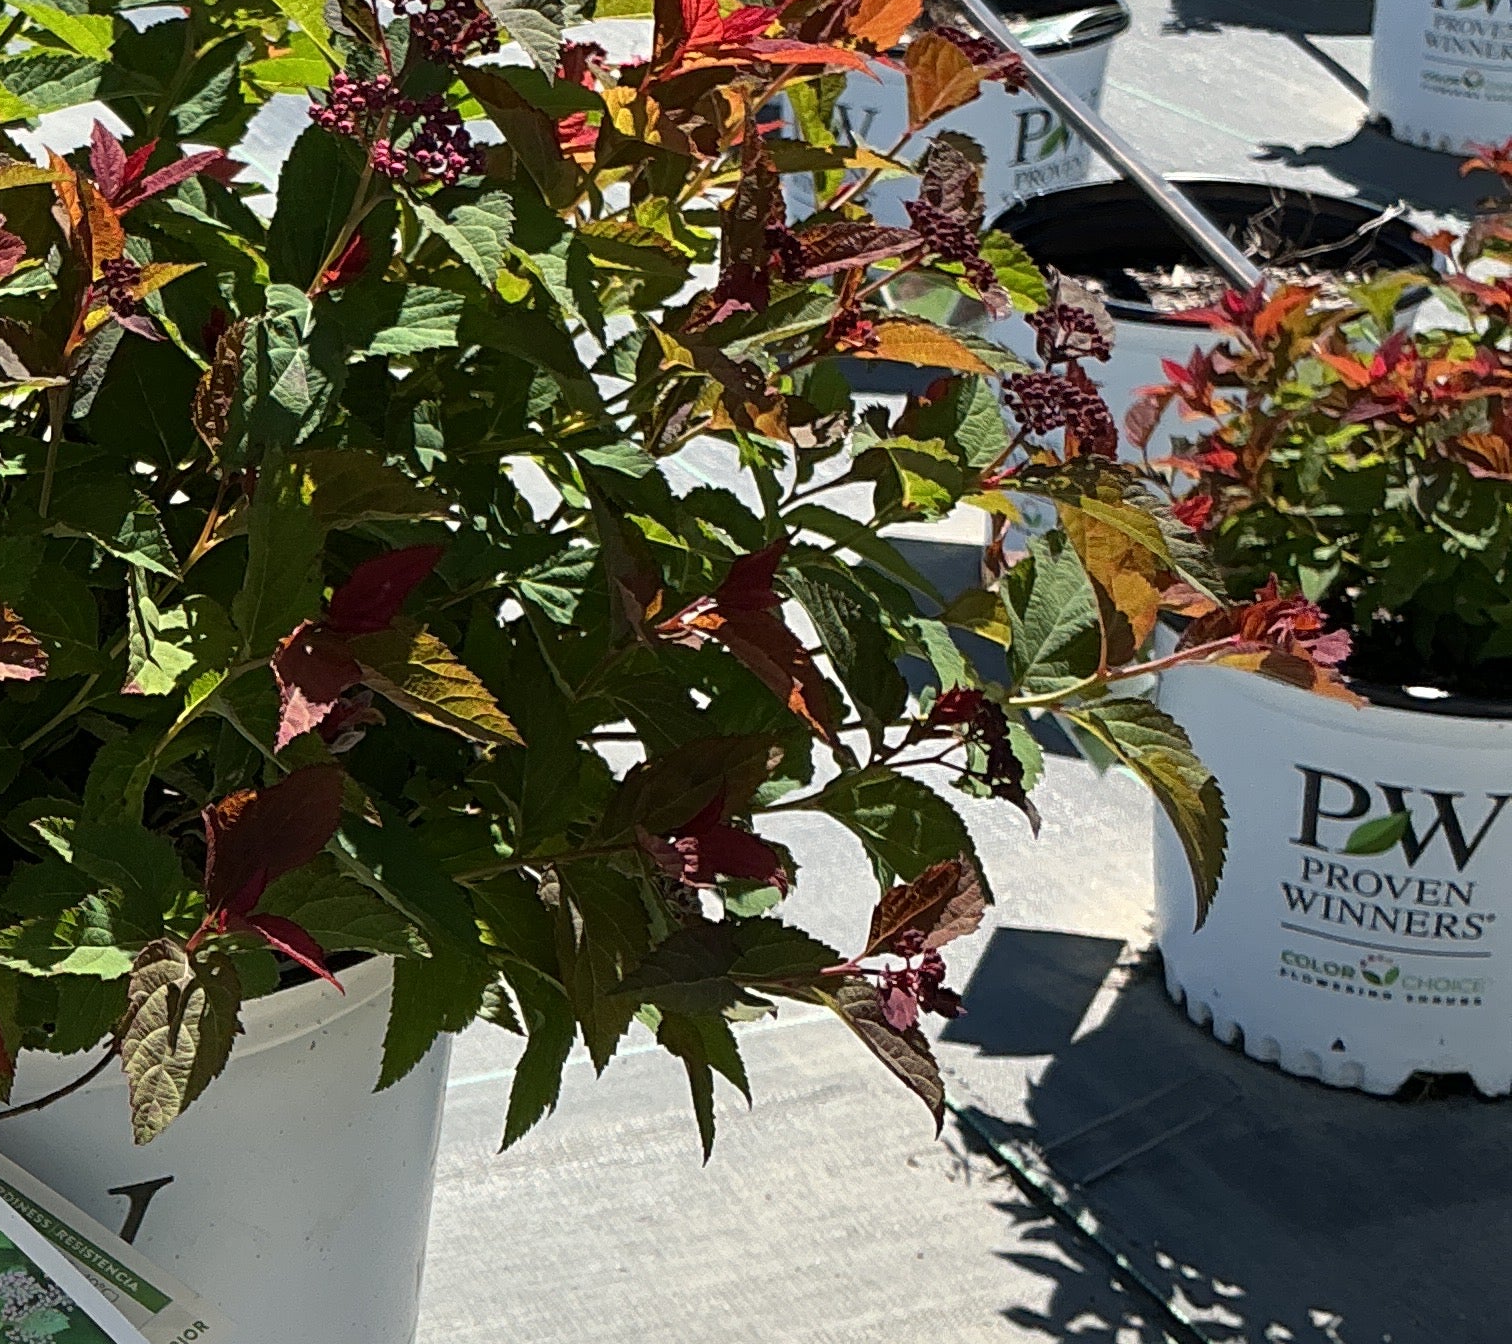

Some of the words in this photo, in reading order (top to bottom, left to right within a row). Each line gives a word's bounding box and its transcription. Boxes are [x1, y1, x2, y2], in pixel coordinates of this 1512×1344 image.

[1289, 763, 1512, 873] PW
[1280, 881, 1496, 941] WINNERS
[1300, 855, 1478, 907] PROVEN
[1280, 949, 1356, 979] COLOR
[55, 1228, 140, 1295] RESISTENCIA
